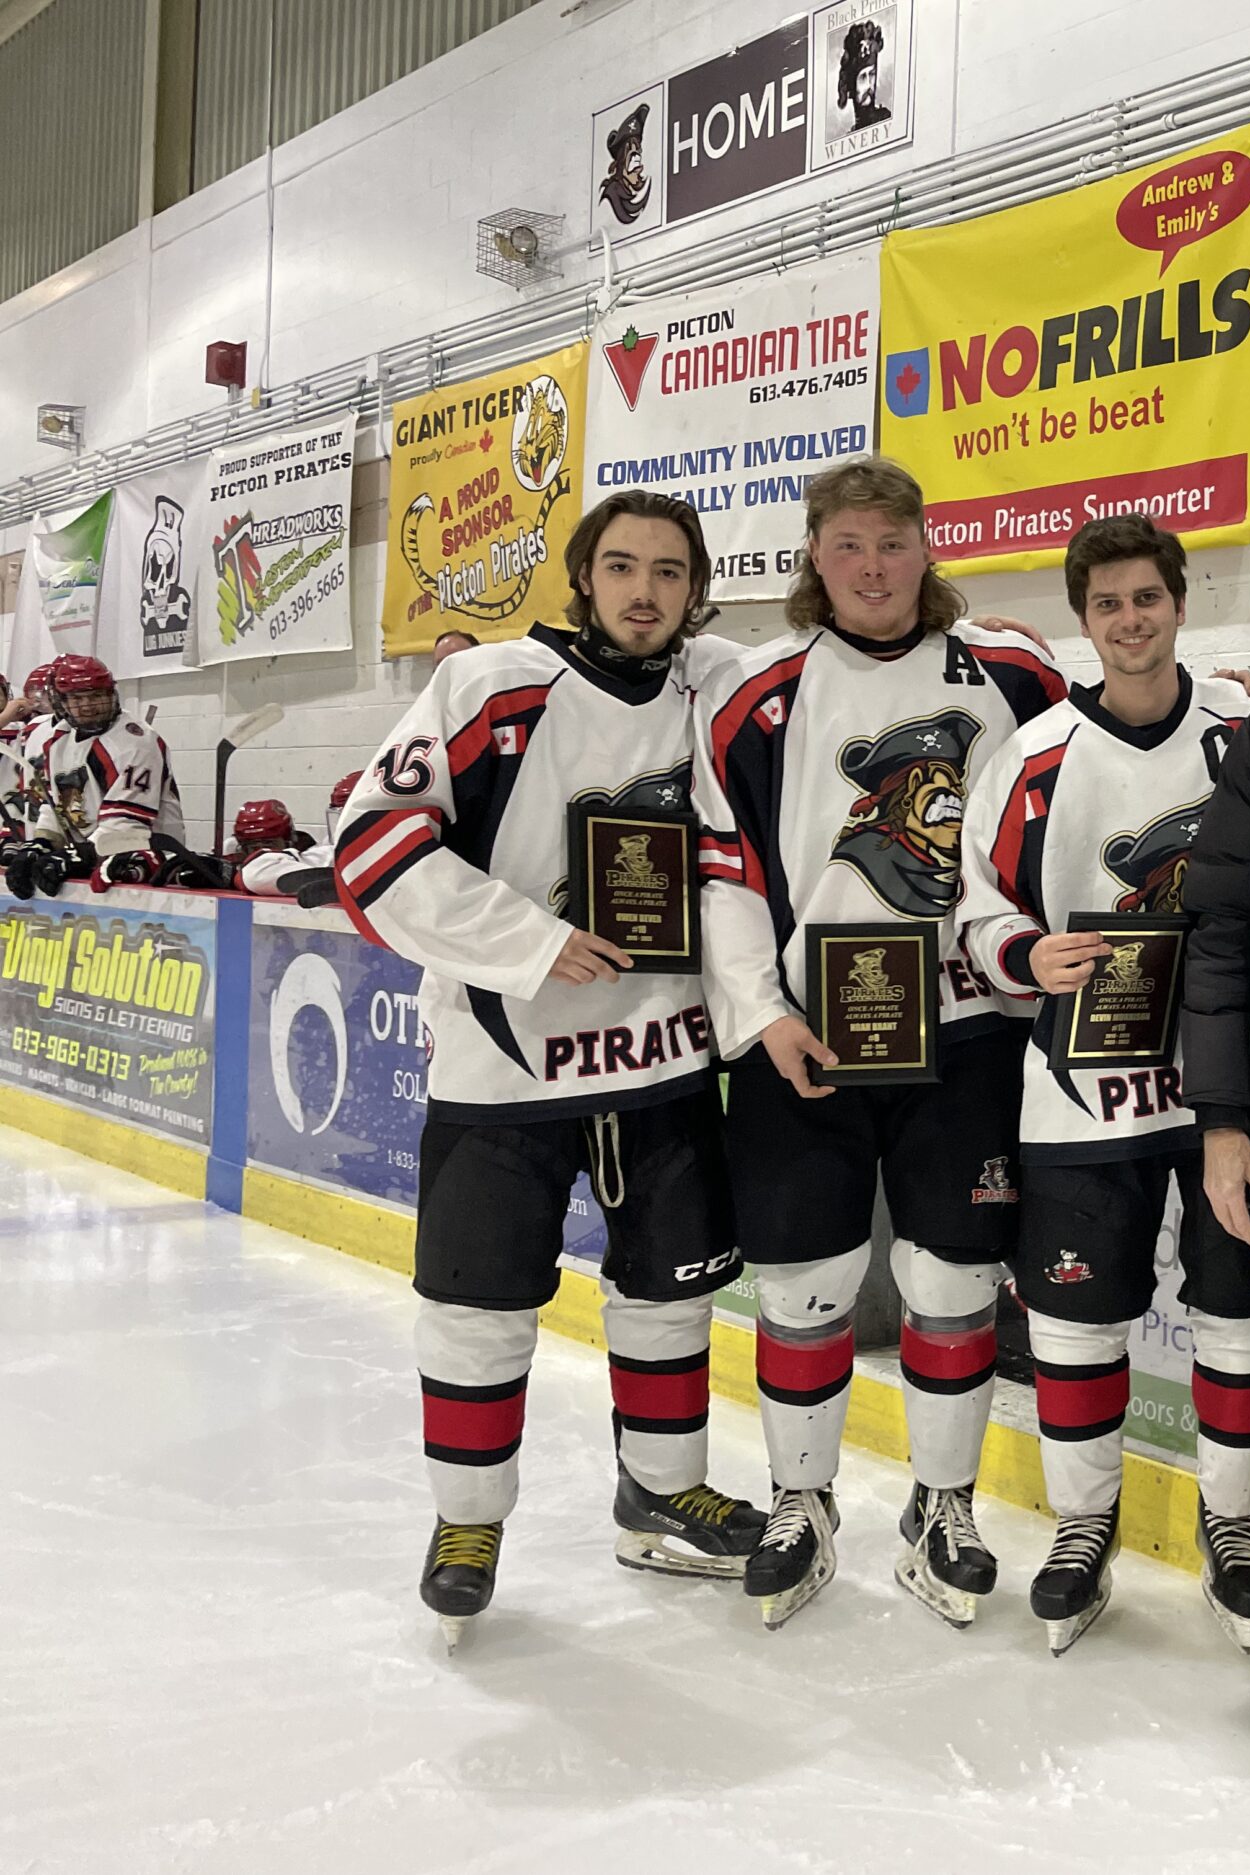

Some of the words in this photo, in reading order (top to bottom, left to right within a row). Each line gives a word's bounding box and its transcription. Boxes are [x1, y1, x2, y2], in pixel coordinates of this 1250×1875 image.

[828, 5, 857, 30] Black
[673, 68, 805, 174] HOME
[825, 122, 892, 160] WINERY
[1142, 170, 1215, 207] Andrew
[1222, 161, 1235, 185] &
[1157, 202, 1219, 239] Emily's
[667, 309, 735, 342] PICTON
[661, 325, 799, 395] CANADIAN
[806, 310, 869, 367] TIRE
[750, 366, 867, 403] 613.476.7405
[396, 405, 458, 447] GIANT
[463, 384, 525, 426] TIGER
[954, 412, 1030, 460] won't
[1041, 407, 1077, 443] be
[1089, 386, 1165, 434] beat
[210, 474, 268, 501] PICTON
[274, 452, 352, 486] PIRATES
[219, 458, 248, 477] PROUD
[250, 443, 302, 468] SUPPORTER
[306, 438, 318, 453] OF
[597, 445, 737, 486] COMMUNITY
[744, 424, 866, 468] INVOLVED
[439, 497, 453, 523] A
[458, 467, 500, 515] PROUD
[745, 475, 809, 507] OWN
[441, 494, 514, 557] SPONSOR
[924, 517, 982, 548] icton
[995, 507, 1073, 540] Pirates
[436, 560, 487, 613] Picton
[490, 526, 547, 588] Pirates
[711, 552, 766, 580] ATES
[269, 563, 345, 640] 613-396-5665
[943, 634, 986, 686] A
[123, 765, 152, 792] 14
[0, 919, 73, 1008] Vinyl
[71, 929, 201, 1017] Solution
[54, 997, 92, 1022] SIGNS
[108, 1008, 194, 1042] LETTERING
[545, 1004, 713, 1082] PIRATE
[393, 1069, 428, 1104] SOL
[387, 1149, 420, 1169] 1-833-
[1129, 1395, 1176, 1428] oors
